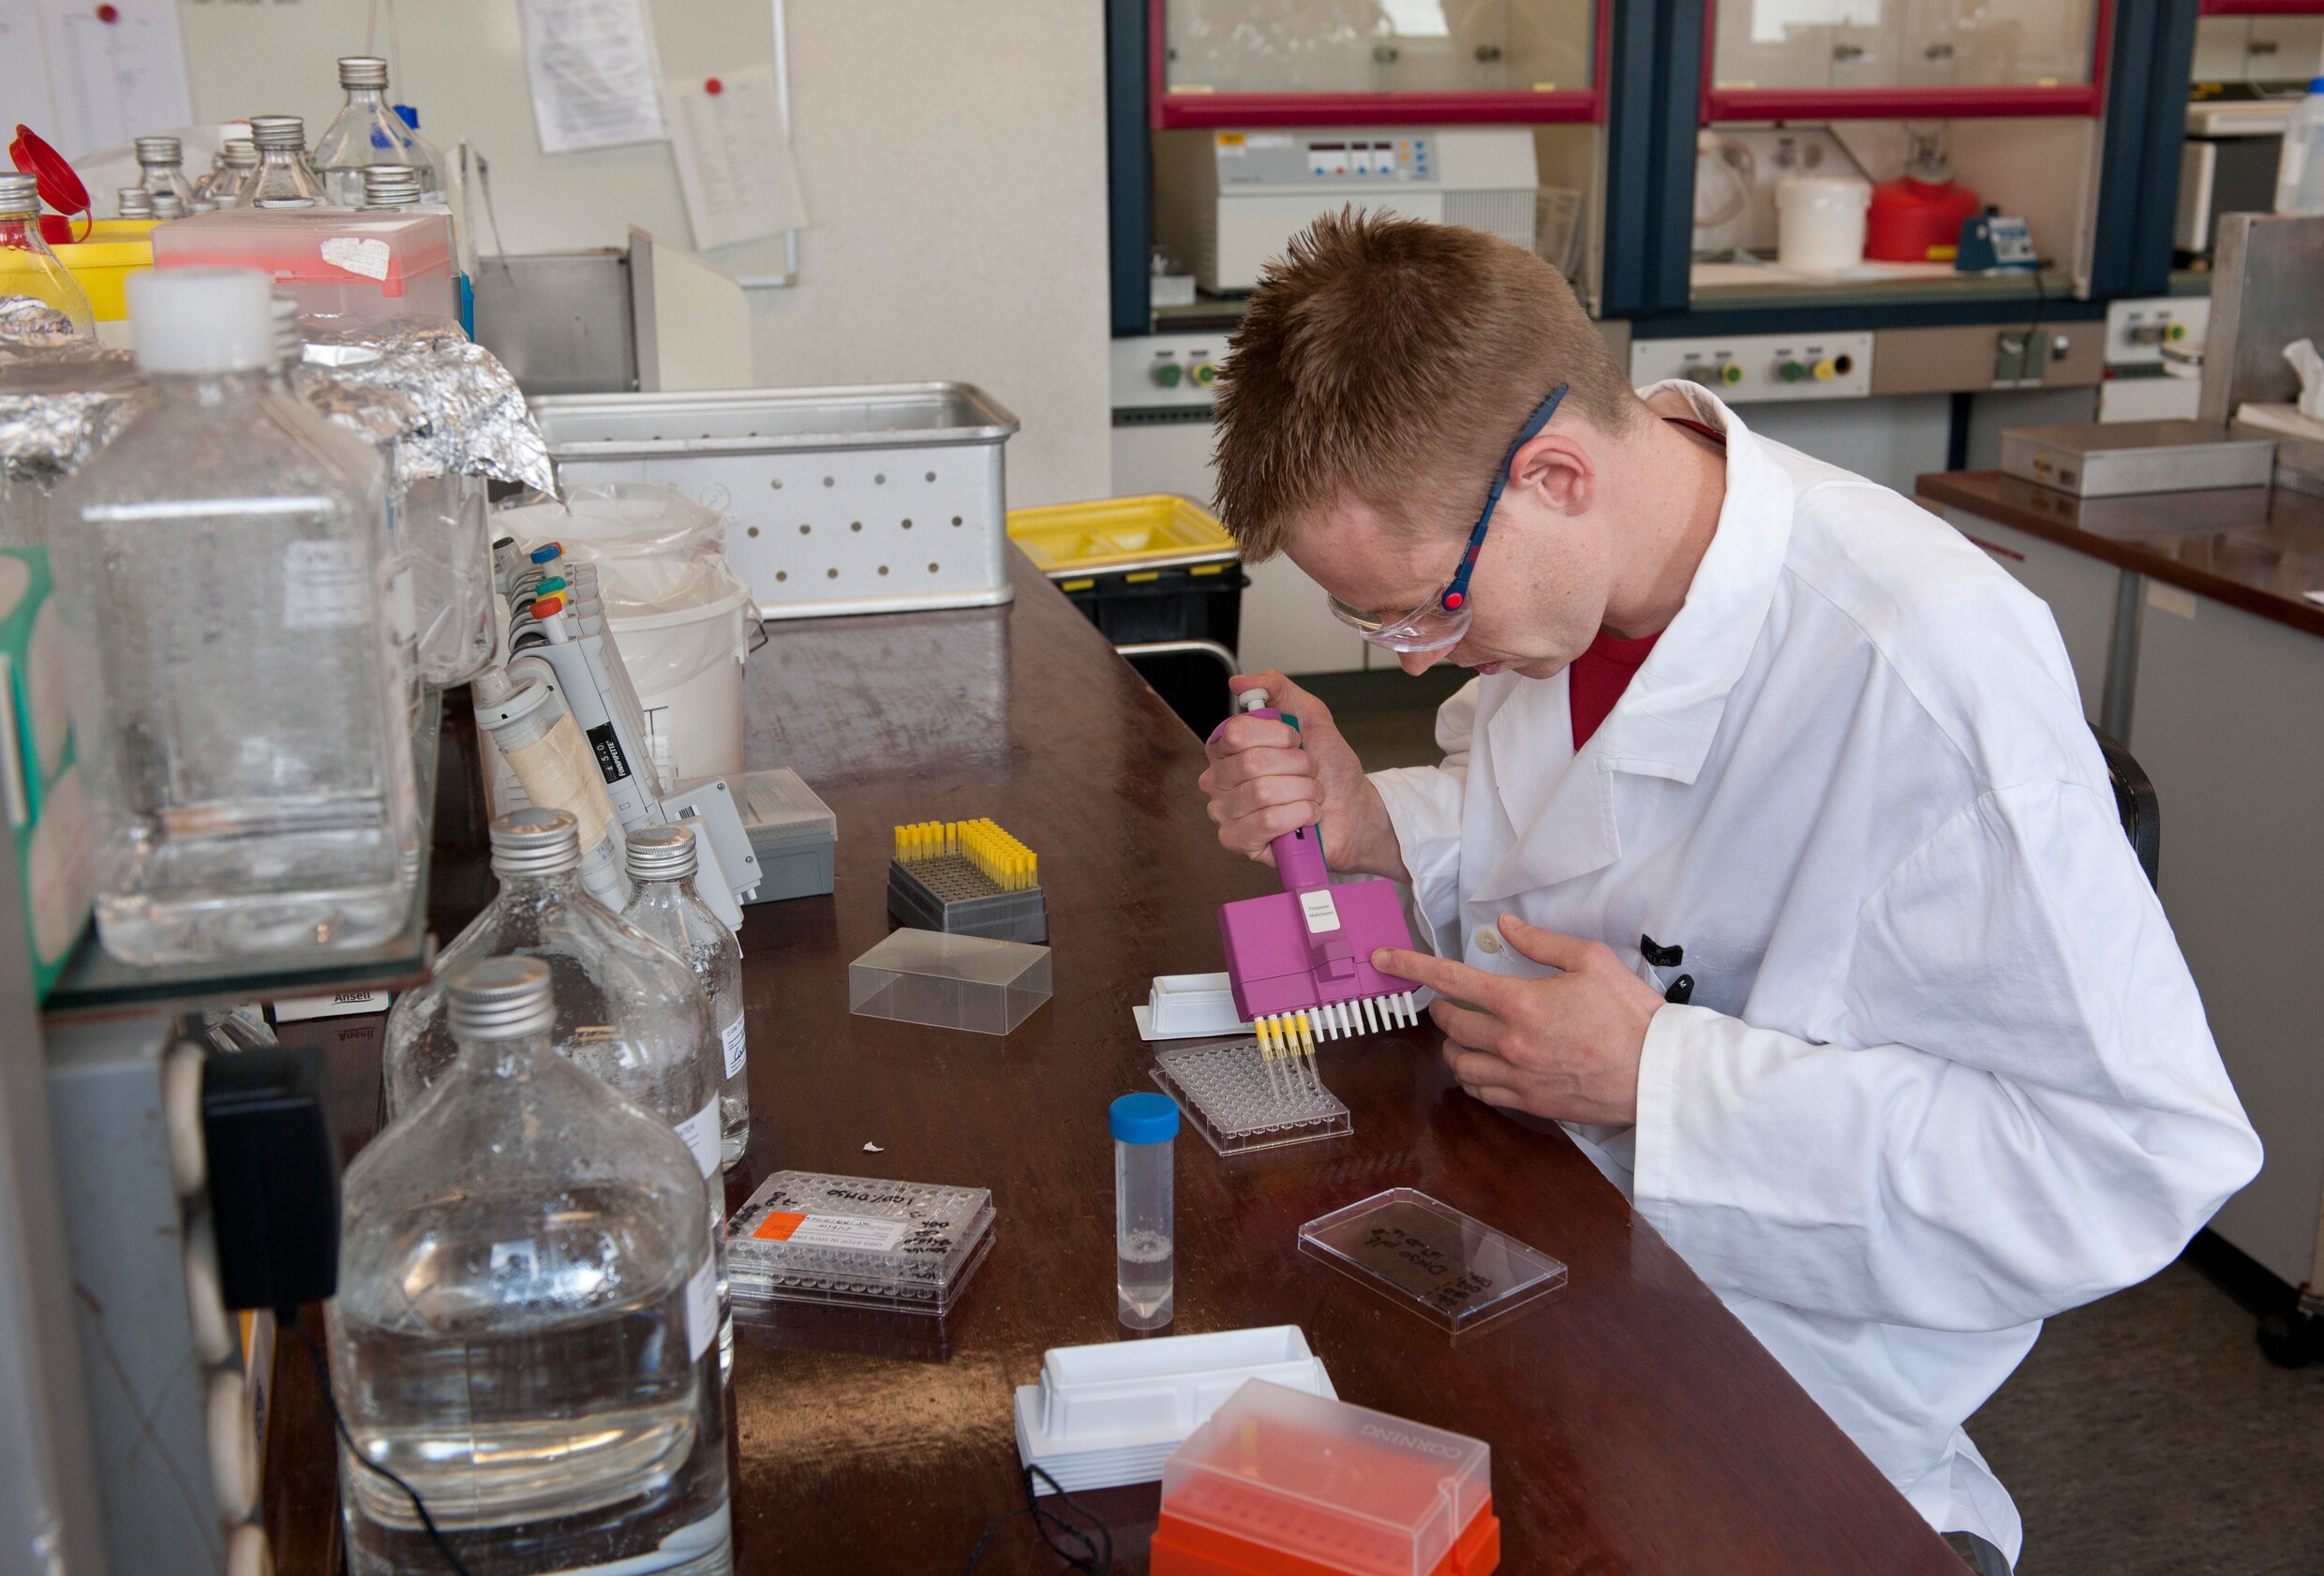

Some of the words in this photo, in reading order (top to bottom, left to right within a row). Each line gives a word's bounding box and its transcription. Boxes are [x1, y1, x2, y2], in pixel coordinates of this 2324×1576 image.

[334, 989, 372, 1003] Ansell
[827, 1189, 870, 1202] DMSO
[1360, 1422, 1462, 1459] CORNING
